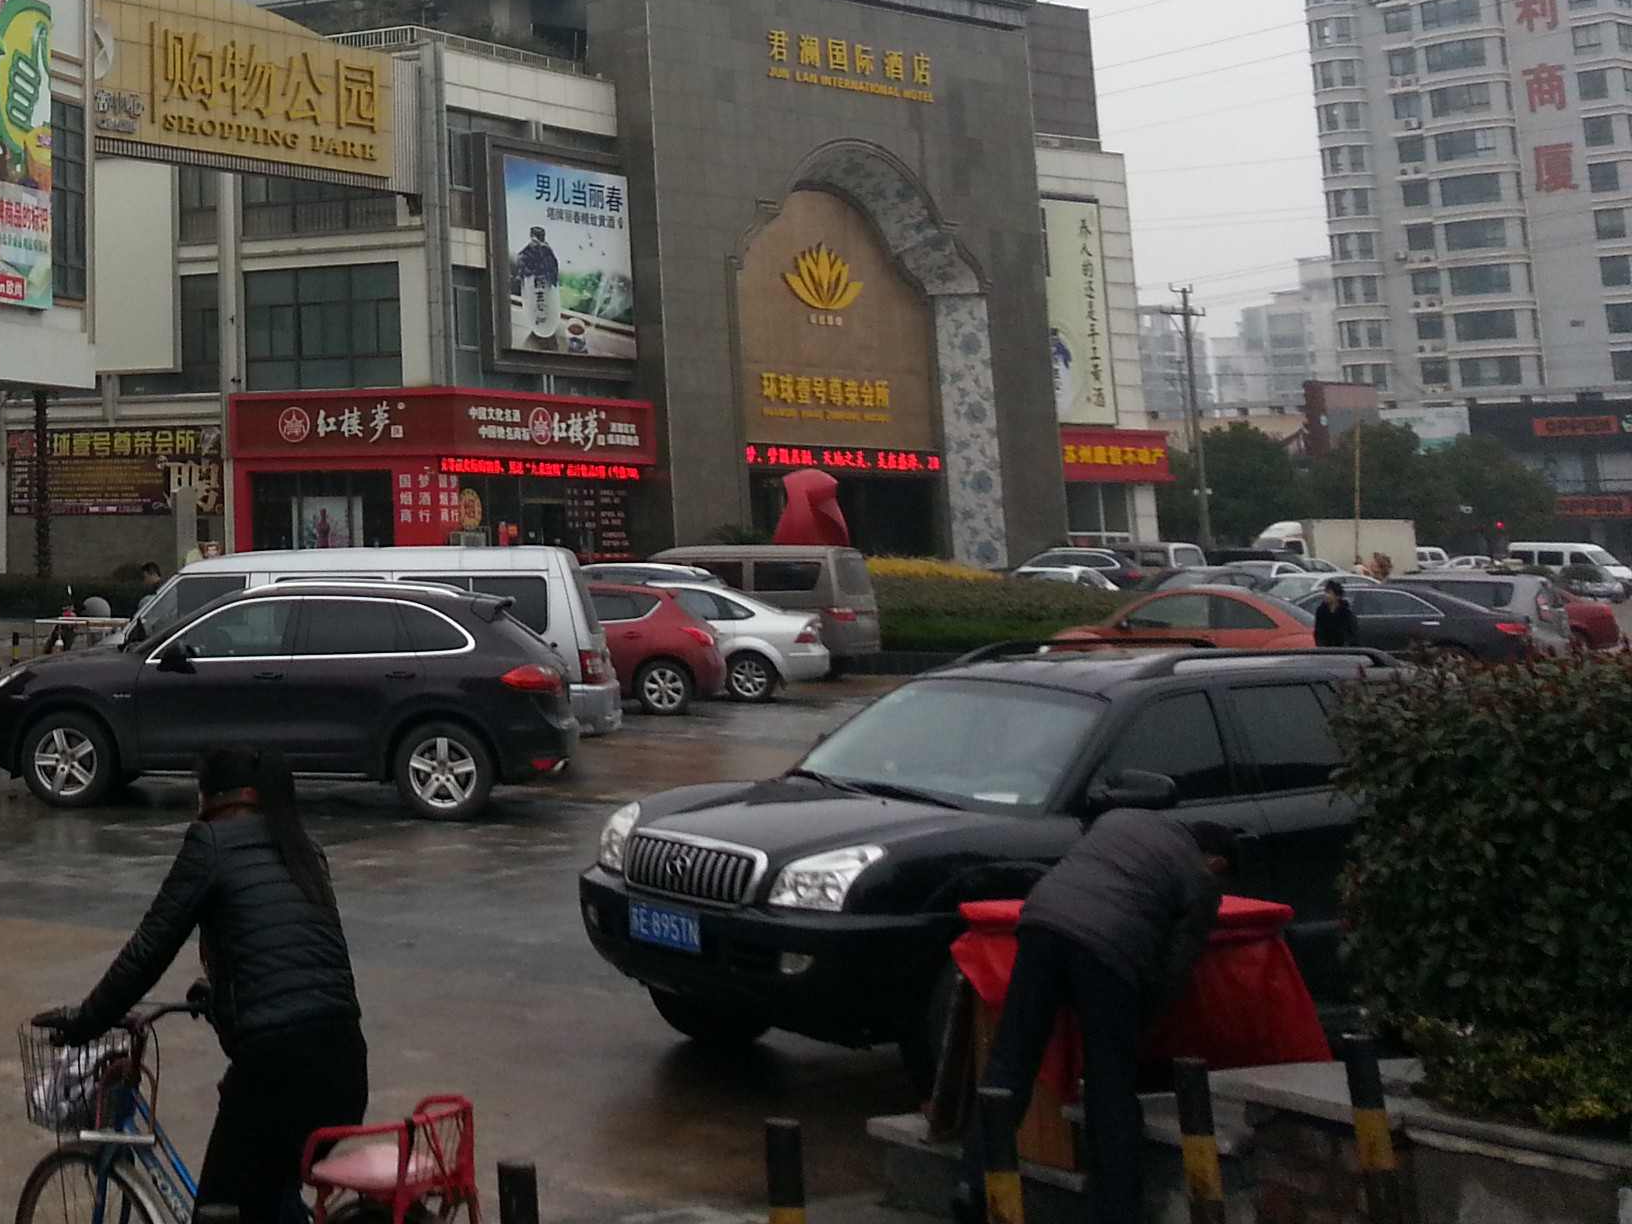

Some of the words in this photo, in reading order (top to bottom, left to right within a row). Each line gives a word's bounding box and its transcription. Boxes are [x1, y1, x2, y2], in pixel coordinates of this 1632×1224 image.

[162, 27, 380, 135] 购物公园
[768, 29, 931, 86] 君澜国际酒店
[820, 76, 900, 97] INTERNATIONAL
[162, 111, 299, 150] SHOPPING
[310, 134, 379, 162] PARK
